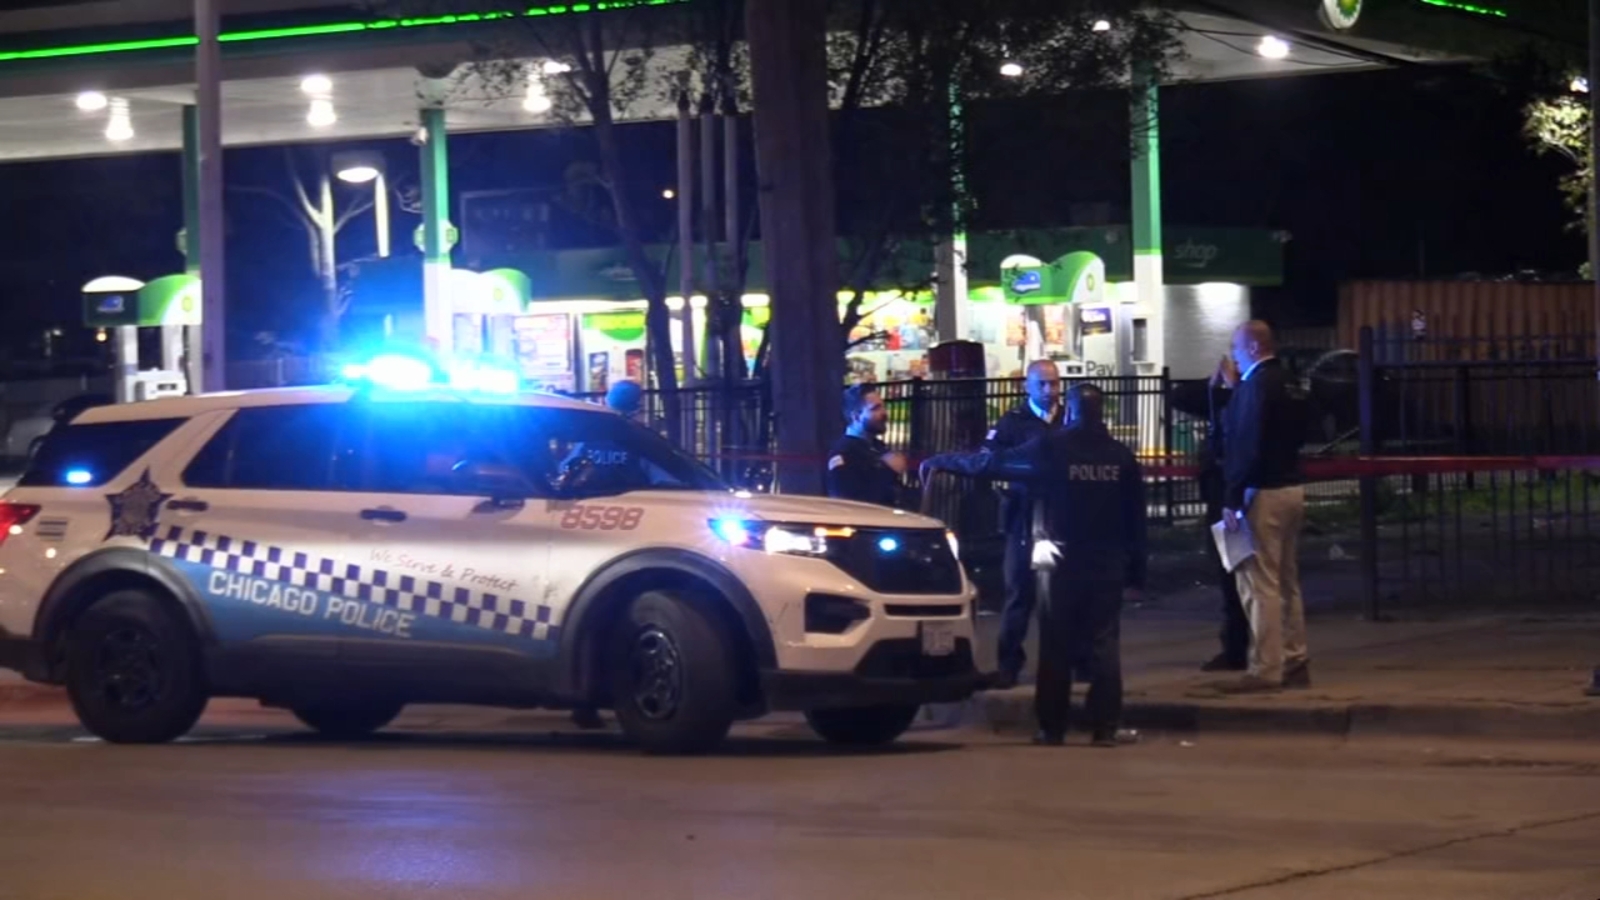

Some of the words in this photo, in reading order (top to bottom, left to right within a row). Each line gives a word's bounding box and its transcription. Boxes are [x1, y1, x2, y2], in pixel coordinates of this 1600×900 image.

[1174, 239, 1218, 267] shop
[586, 449, 629, 465] POLICE
[1068, 464, 1120, 481] POLICE
[561, 505, 644, 531] 8598
[370, 548, 392, 563] We
[394, 553, 437, 574] Serve
[441, 564, 454, 578] &
[460, 568, 519, 591] Protect
[207, 570, 317, 616] CHICAGO
[325, 595, 418, 638] POLICE
